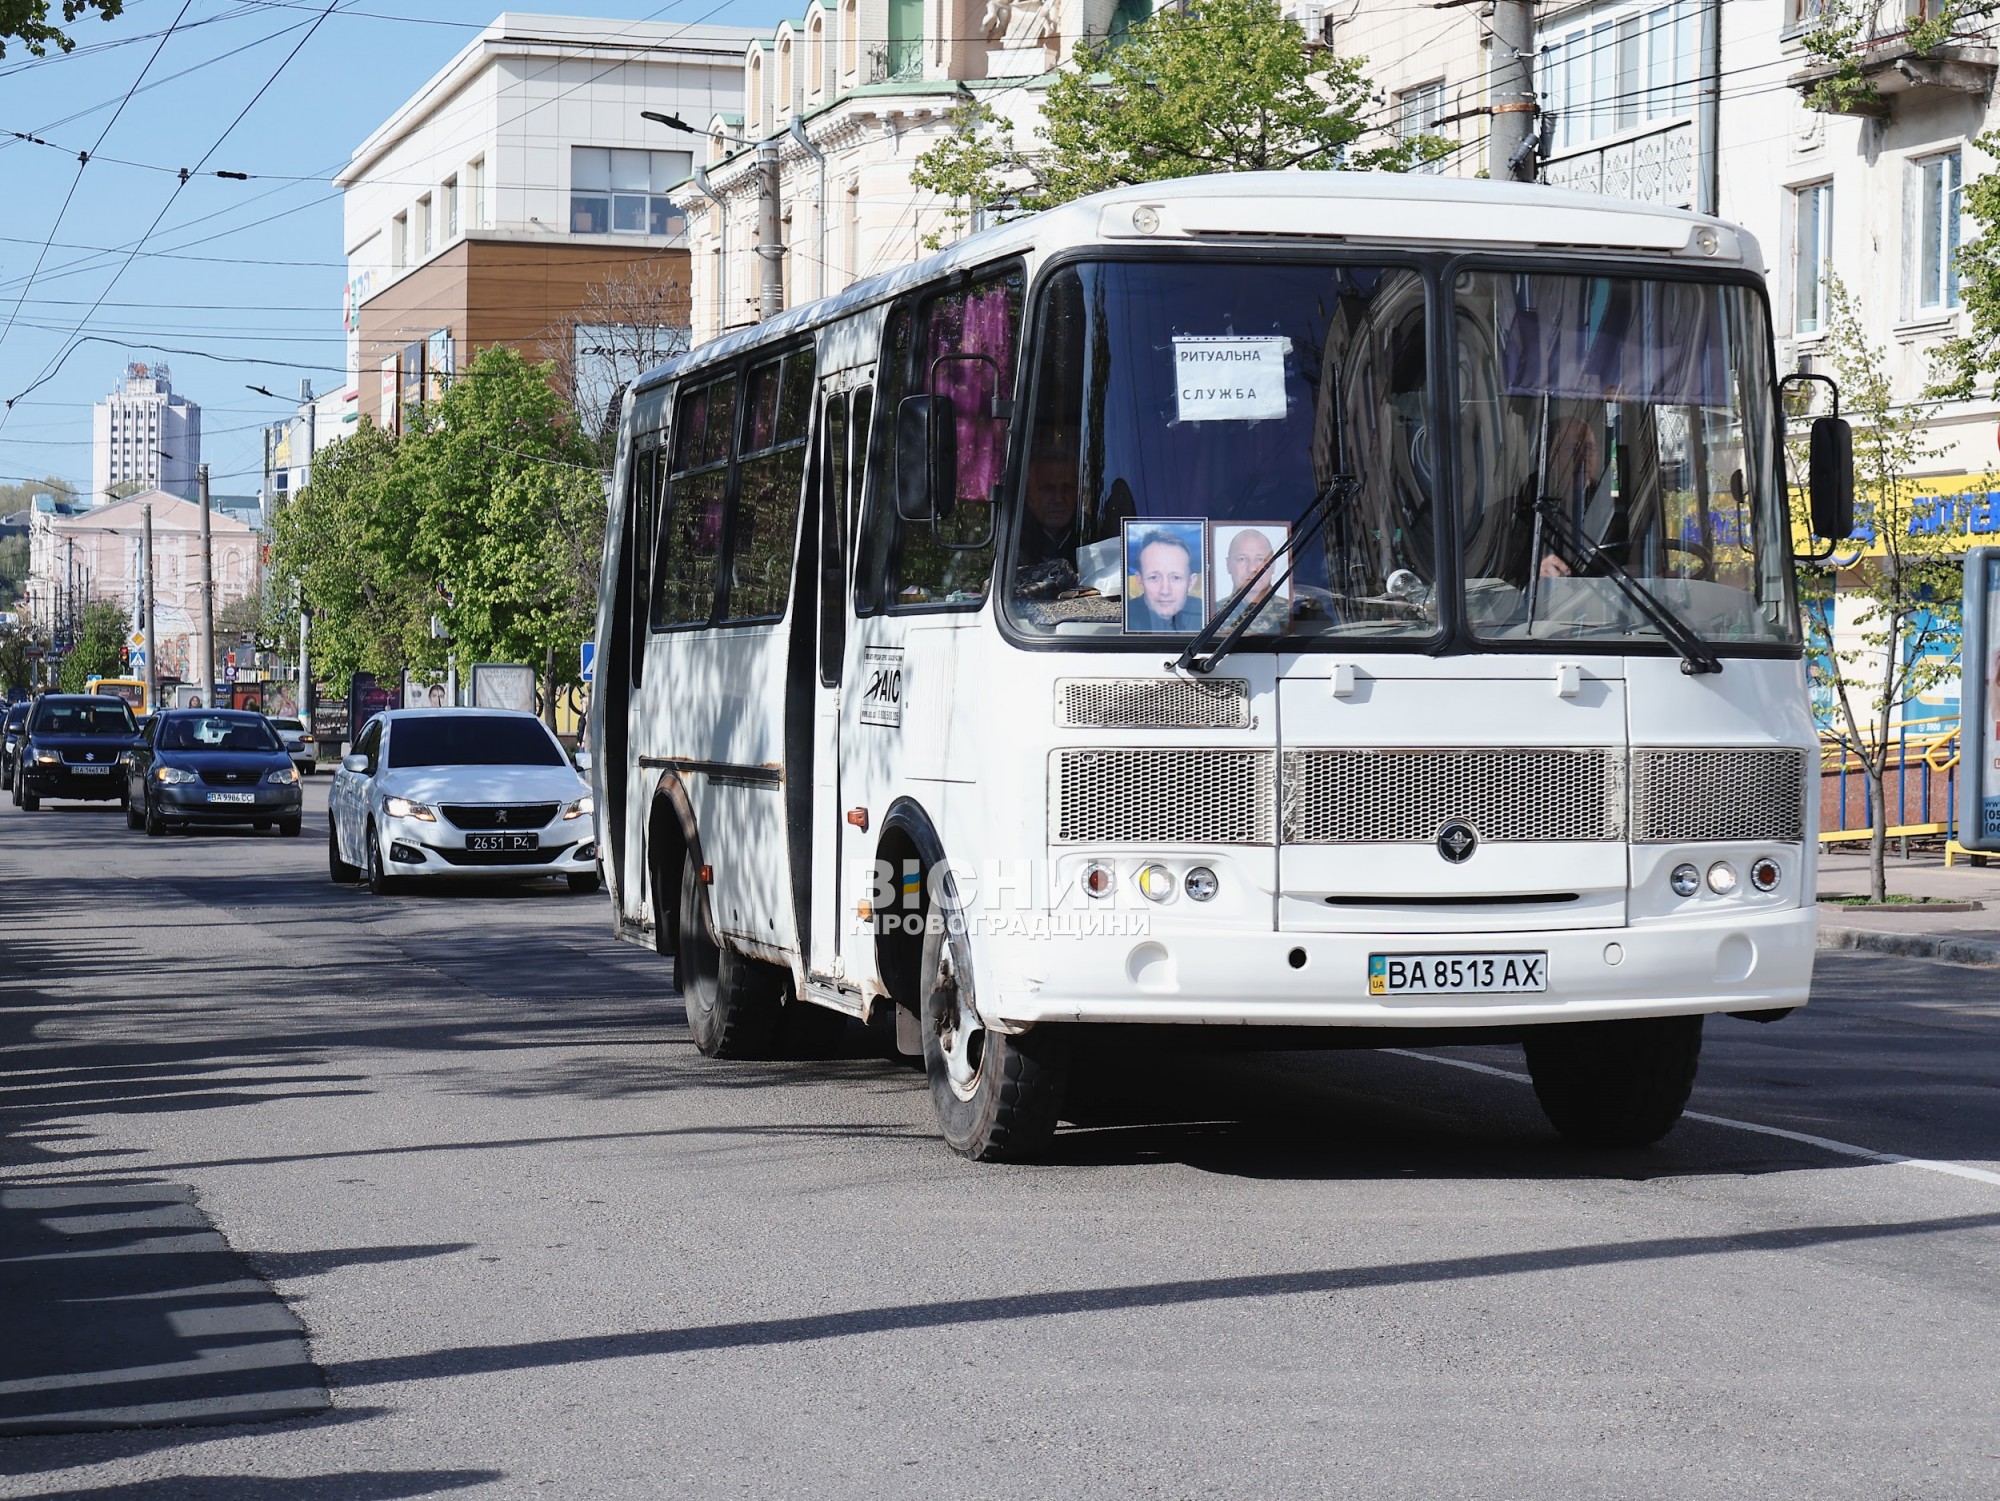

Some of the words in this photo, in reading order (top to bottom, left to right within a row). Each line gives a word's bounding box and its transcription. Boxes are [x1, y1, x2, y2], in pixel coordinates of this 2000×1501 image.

[1181, 350, 1261, 362] РИТУАЛЬНА
[1182, 388, 1257, 400] СЛУЖБА
[211, 793, 222, 802] BA
[223, 793, 240, 802] 9986
[1388, 961, 1427, 989] BA
[1434, 960, 1494, 988] 8513
[1502, 959, 1540, 987] AX
[1372, 981, 1385, 989] UA
